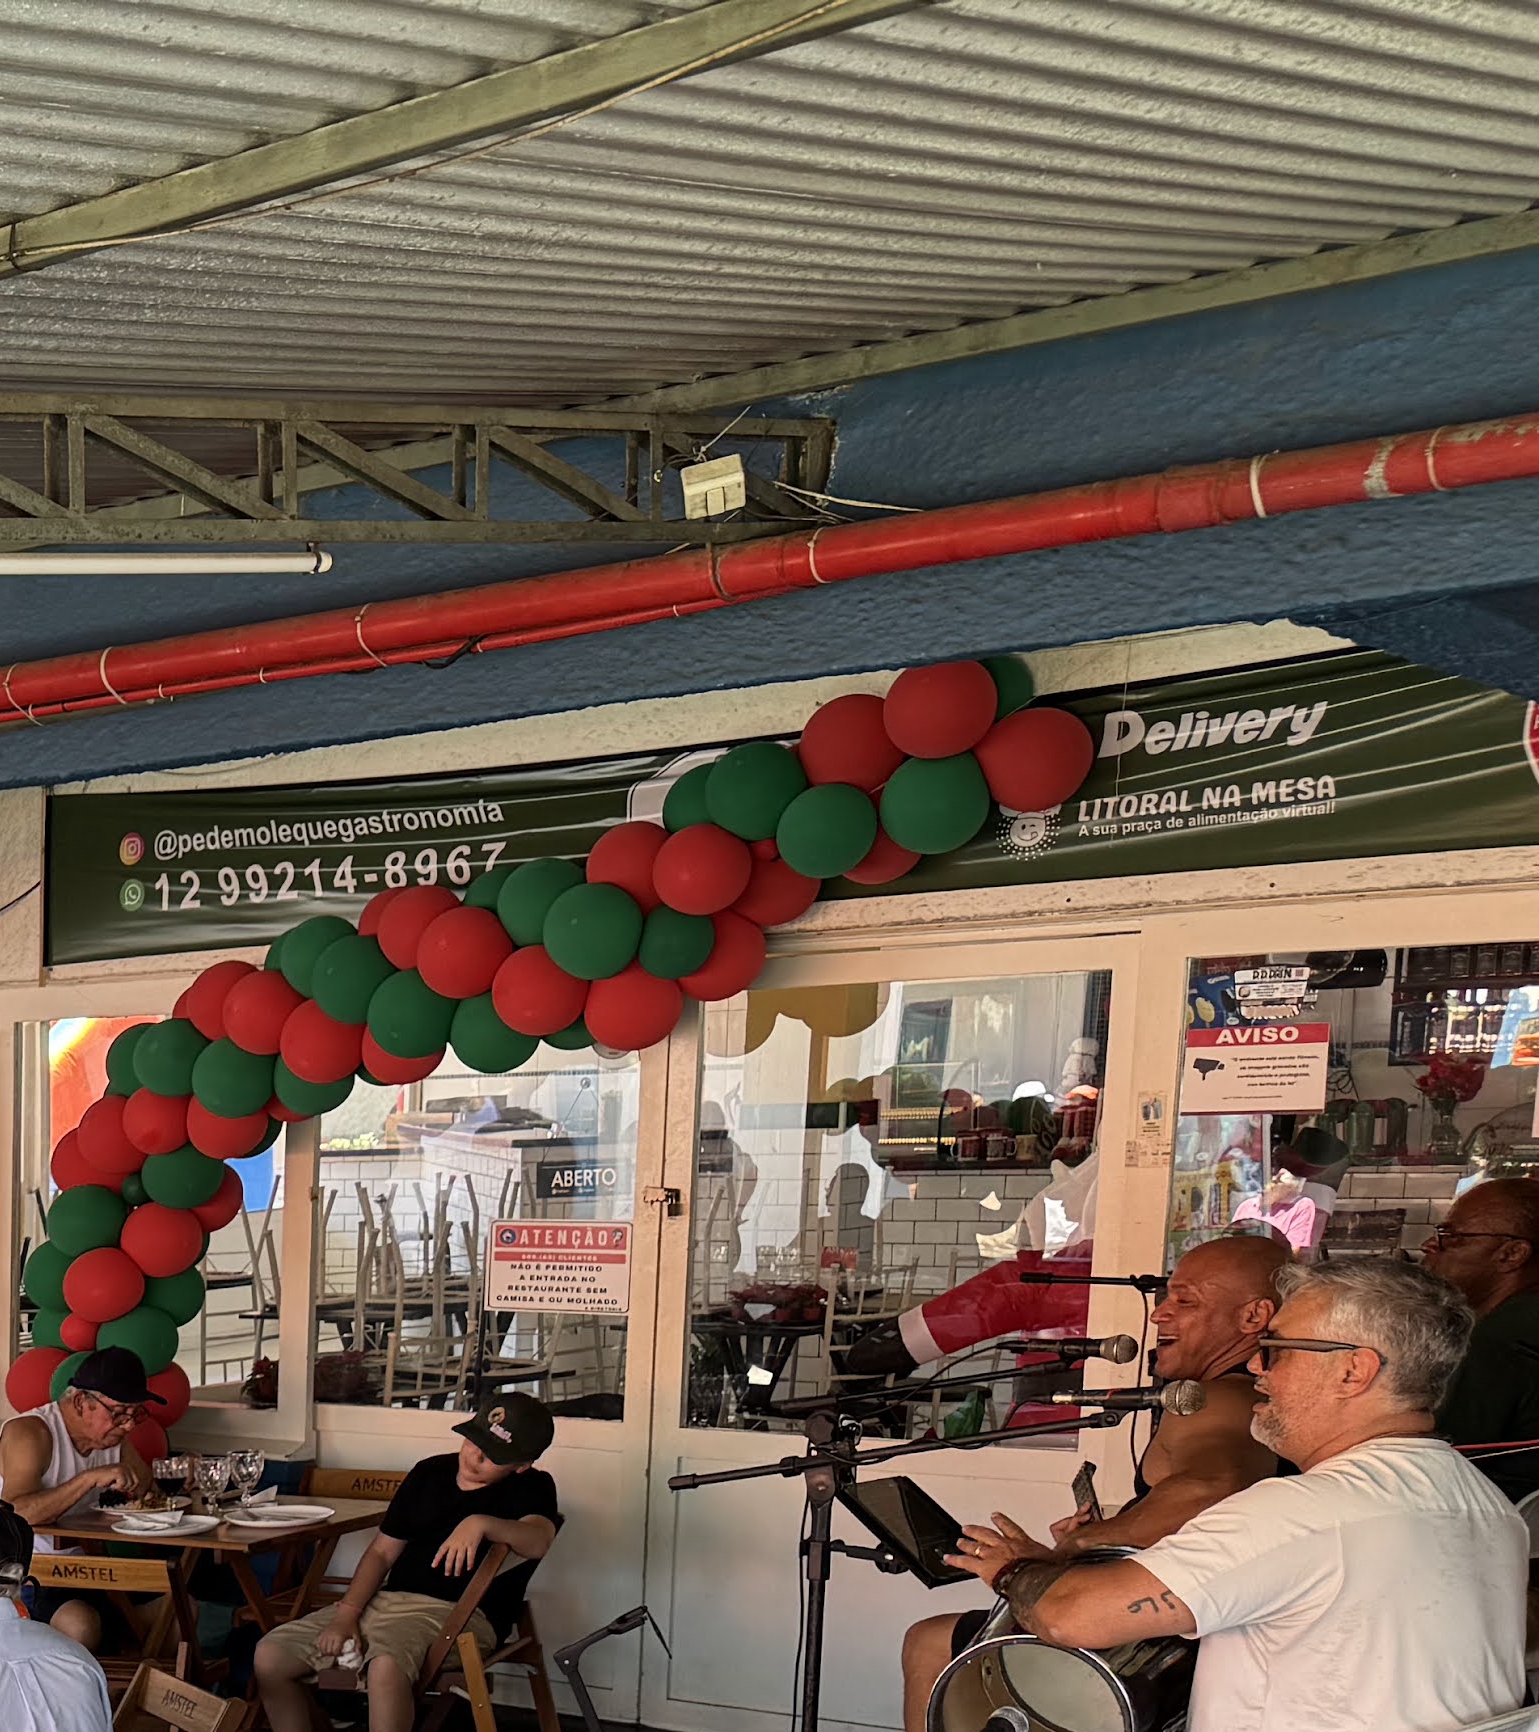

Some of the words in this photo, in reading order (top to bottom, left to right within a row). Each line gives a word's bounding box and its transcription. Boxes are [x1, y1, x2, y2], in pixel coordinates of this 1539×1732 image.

[1097, 701, 1328, 758] Delivery
[1078, 789, 1192, 822] LITORAL
[1201, 784, 1241, 809] NA
[1252, 775, 1337, 805] MESA
[1079, 824, 1089, 836] A
[1093, 823, 1118, 835] sua
[1122, 817, 1162, 836] praça
[1166, 814, 1184, 829] de
[1188, 807, 1279, 826] alimentação
[1282, 801, 1336, 818] virtual!
[155, 869, 201, 911] 12
[217, 841, 507, 907] 99214-8967
[1216, 1026, 1299, 1045] AVISO
[551, 1167, 617, 1188] ABERTO
[519, 1227, 608, 1249] ATENÇÃO
[510, 1262, 531, 1270] NÃO
[545, 1264, 602, 1272] PERMITIDO
[508, 1285, 582, 1294] RESTAURANTE
[567, 1297, 618, 1305] MOLHADO
[52, 1564, 118, 1582] AMSTEL
[162, 1689, 198, 1720] AMSTEL
